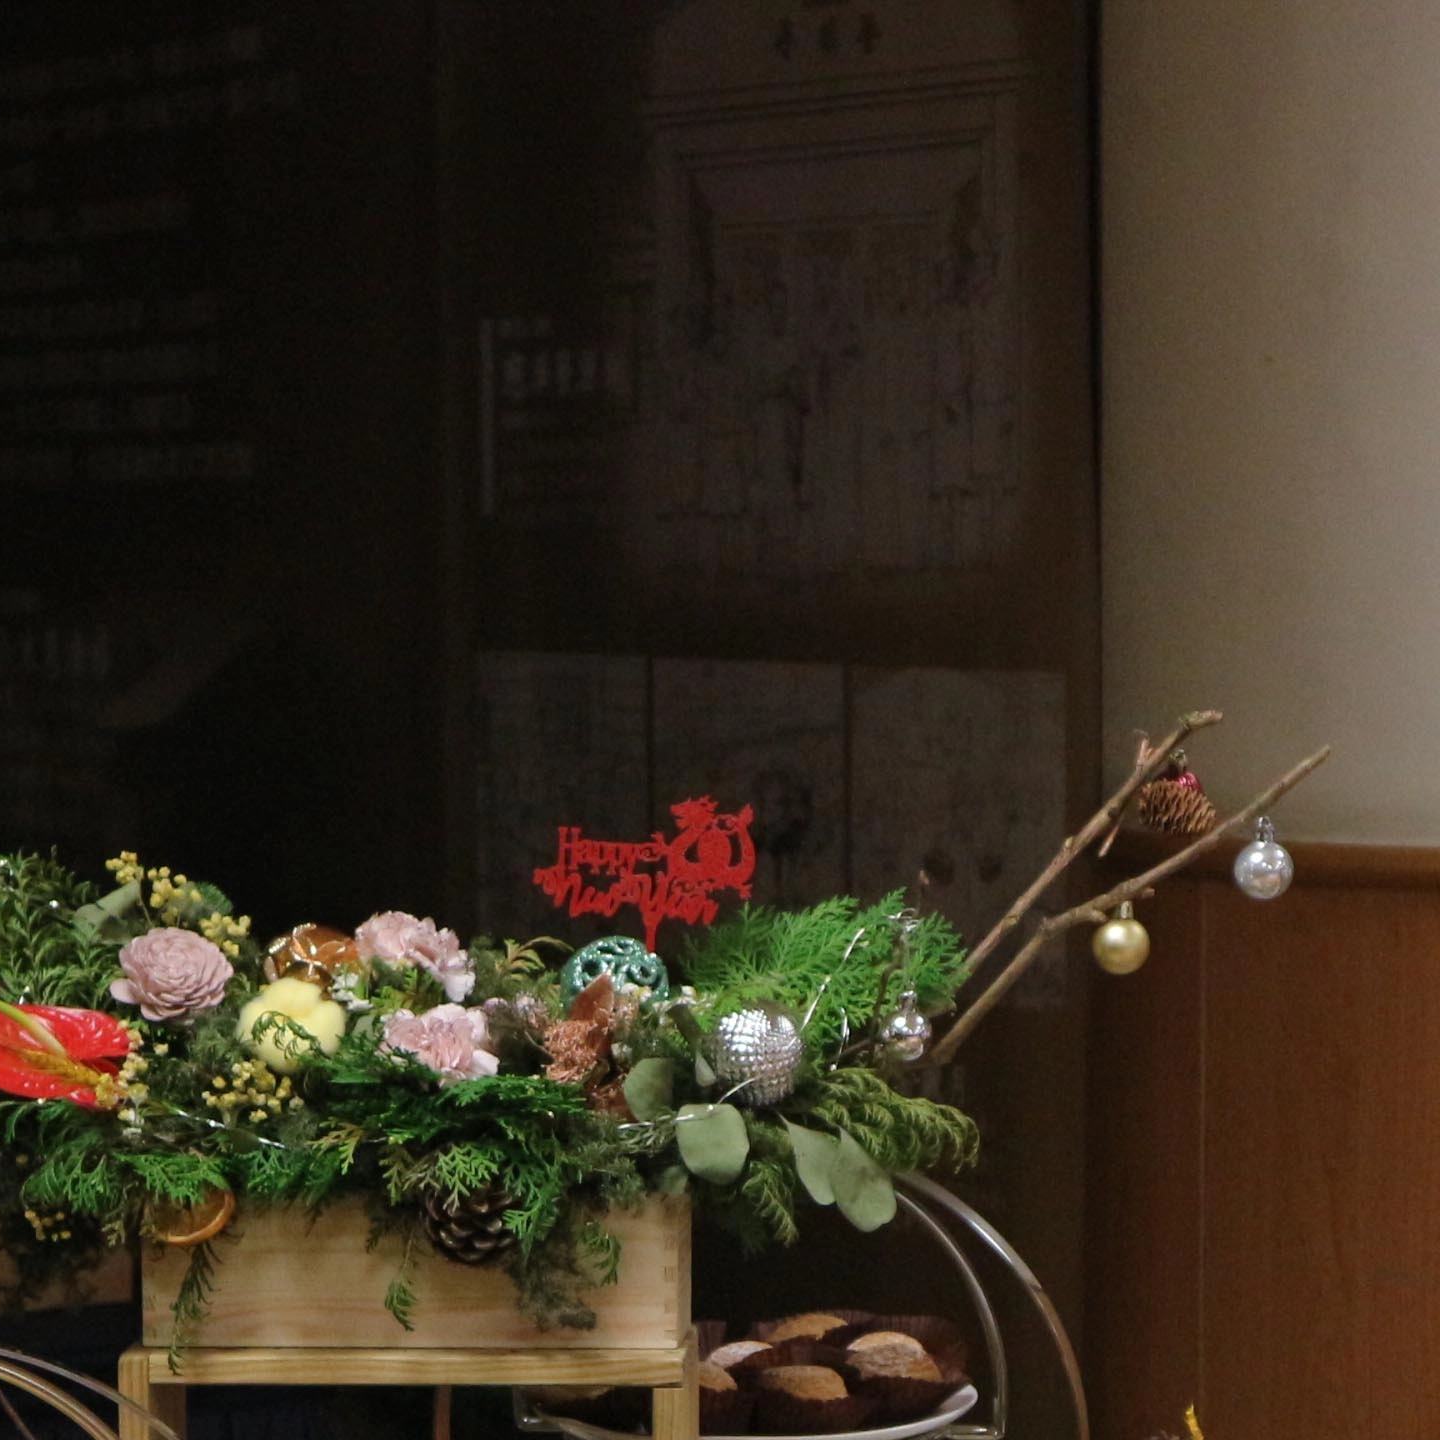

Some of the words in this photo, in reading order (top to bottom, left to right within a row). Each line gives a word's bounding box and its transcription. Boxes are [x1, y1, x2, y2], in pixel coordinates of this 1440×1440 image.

[558, 826, 659, 876] Happy
[533, 866, 620, 917] New
[620, 870, 718, 925] Year
